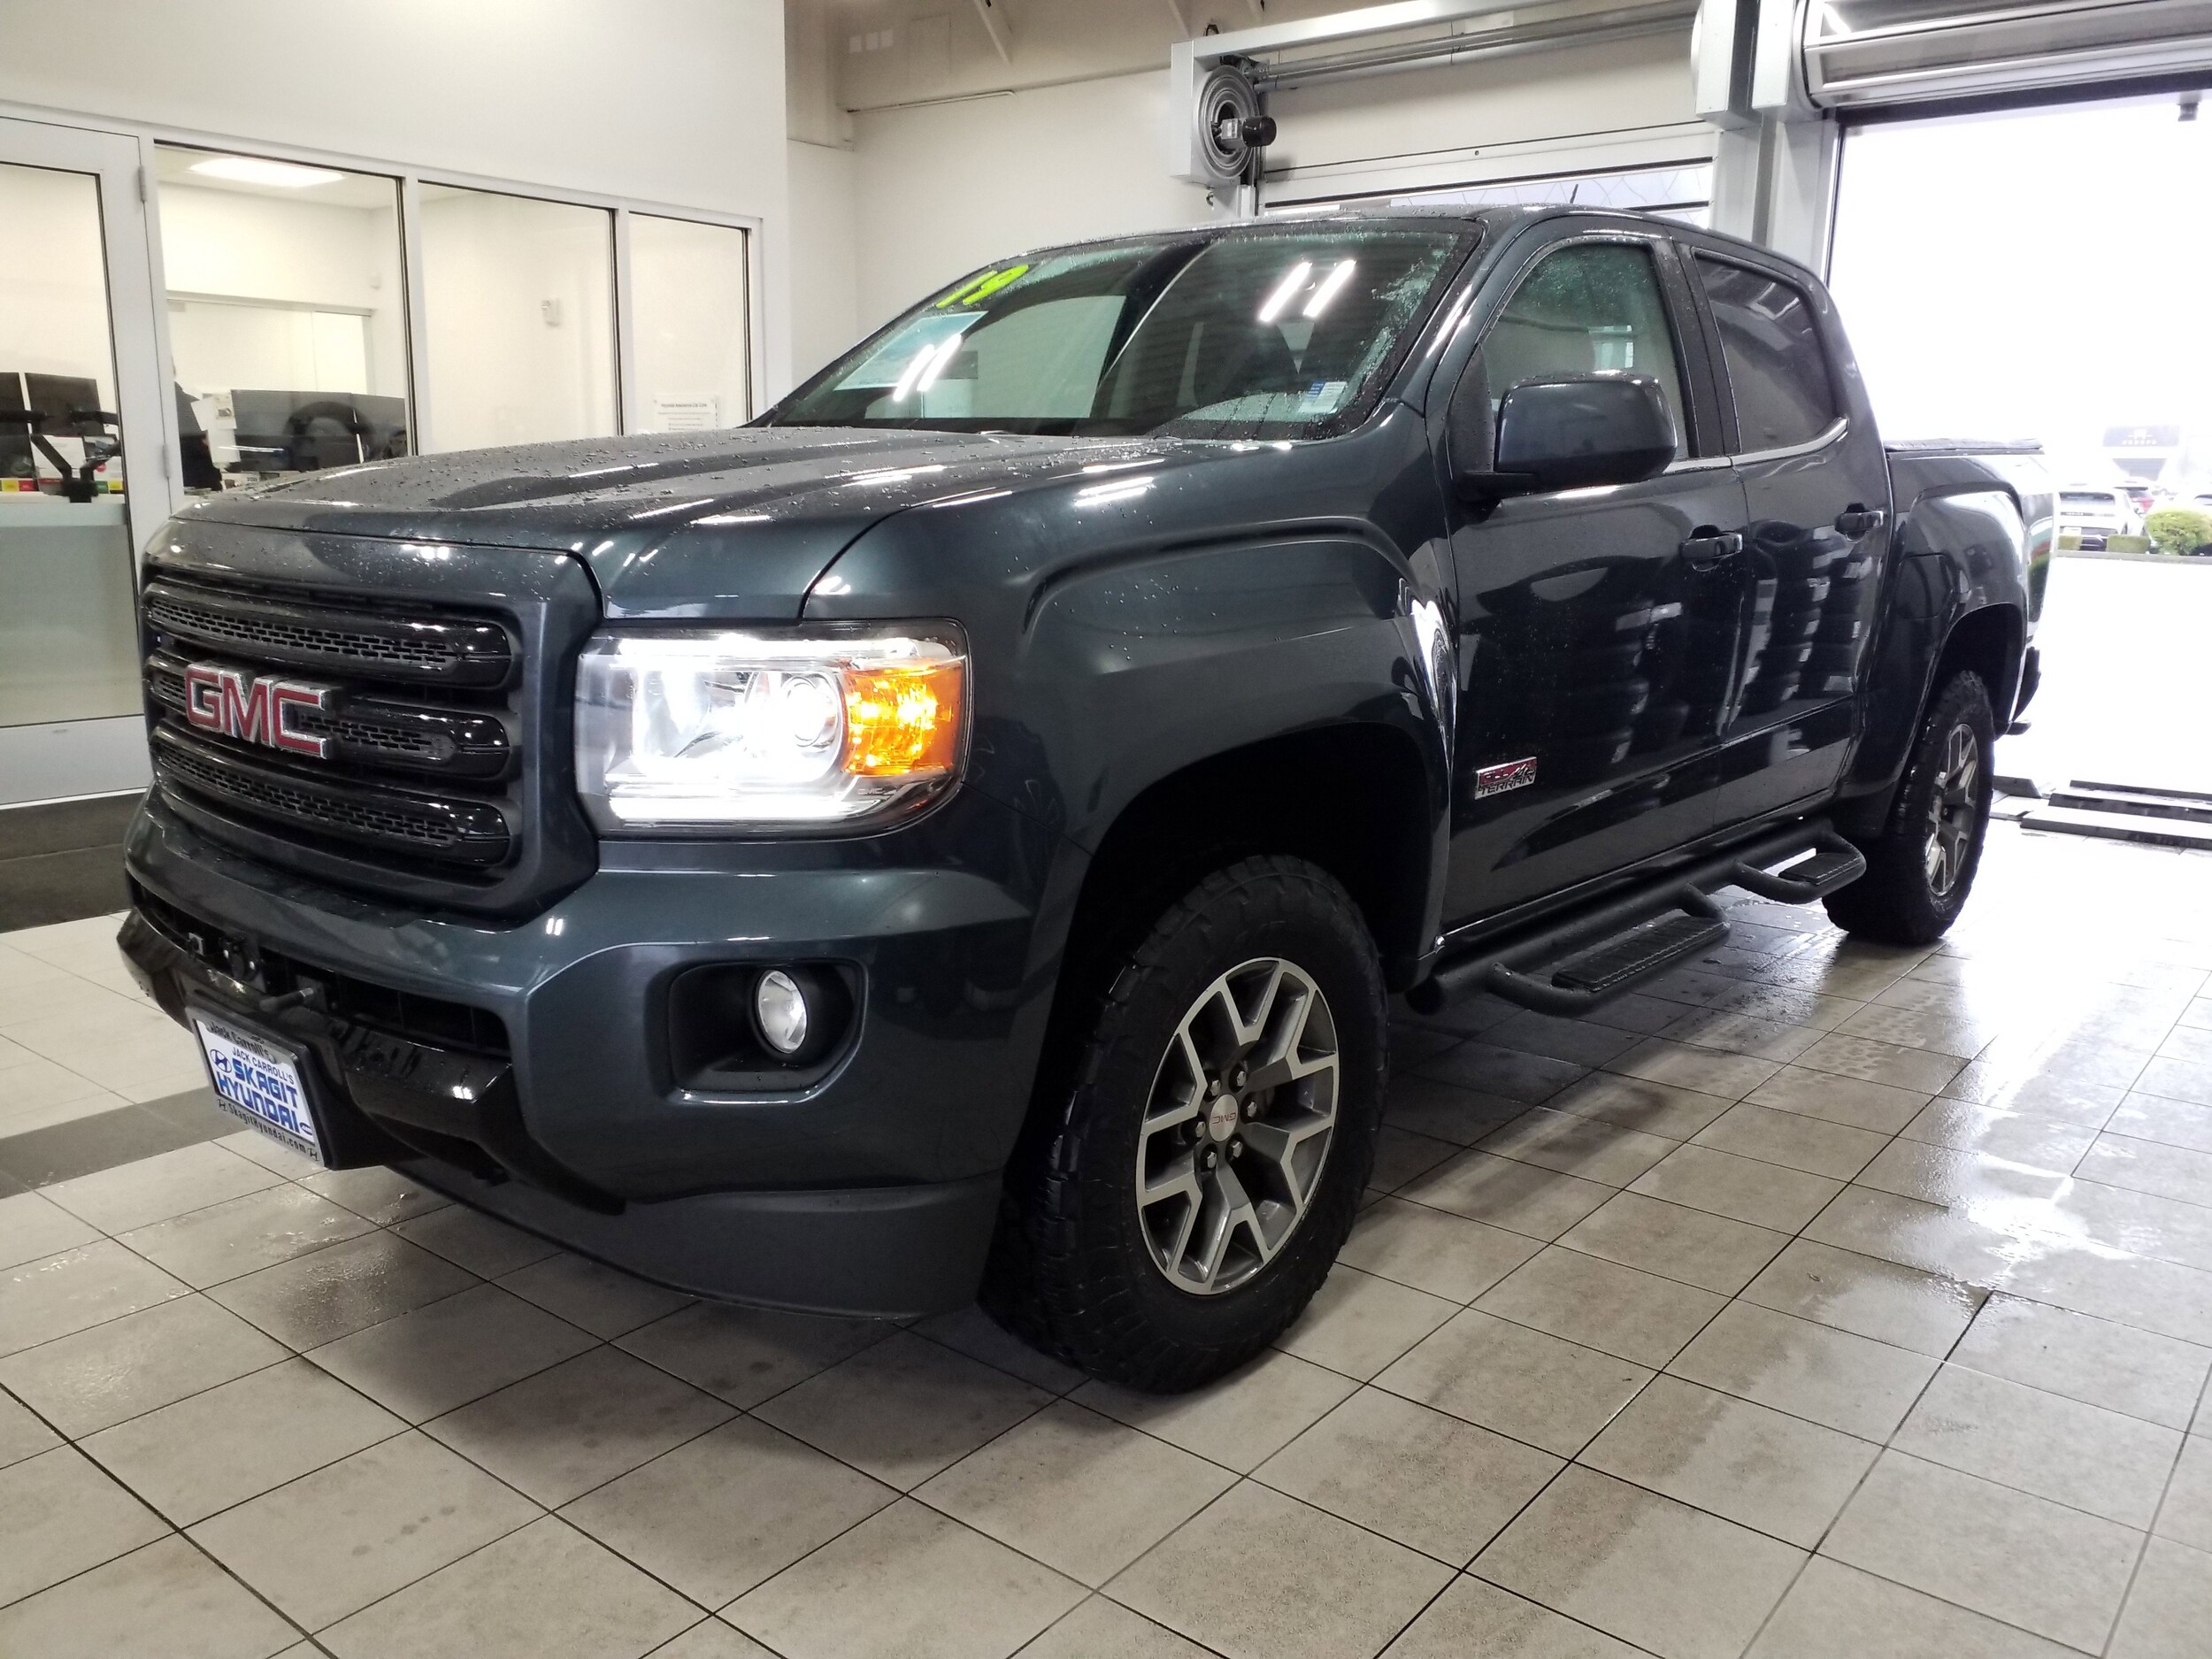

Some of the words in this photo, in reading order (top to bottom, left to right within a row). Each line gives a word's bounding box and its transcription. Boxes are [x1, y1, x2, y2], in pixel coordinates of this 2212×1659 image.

[185, 662, 327, 760] GMC
[231, 1031, 269, 1057] Carroll's
[232, 1047, 252, 1064] JACK
[252, 1058, 295, 1085] CARROLL'S
[216, 1071, 301, 1133] HYUNDAI
[232, 1059, 298, 1110] SKAGIT
[228, 1102, 307, 1154] SkagitHyundai.com
[1212, 1112, 1236, 1124] GMC
